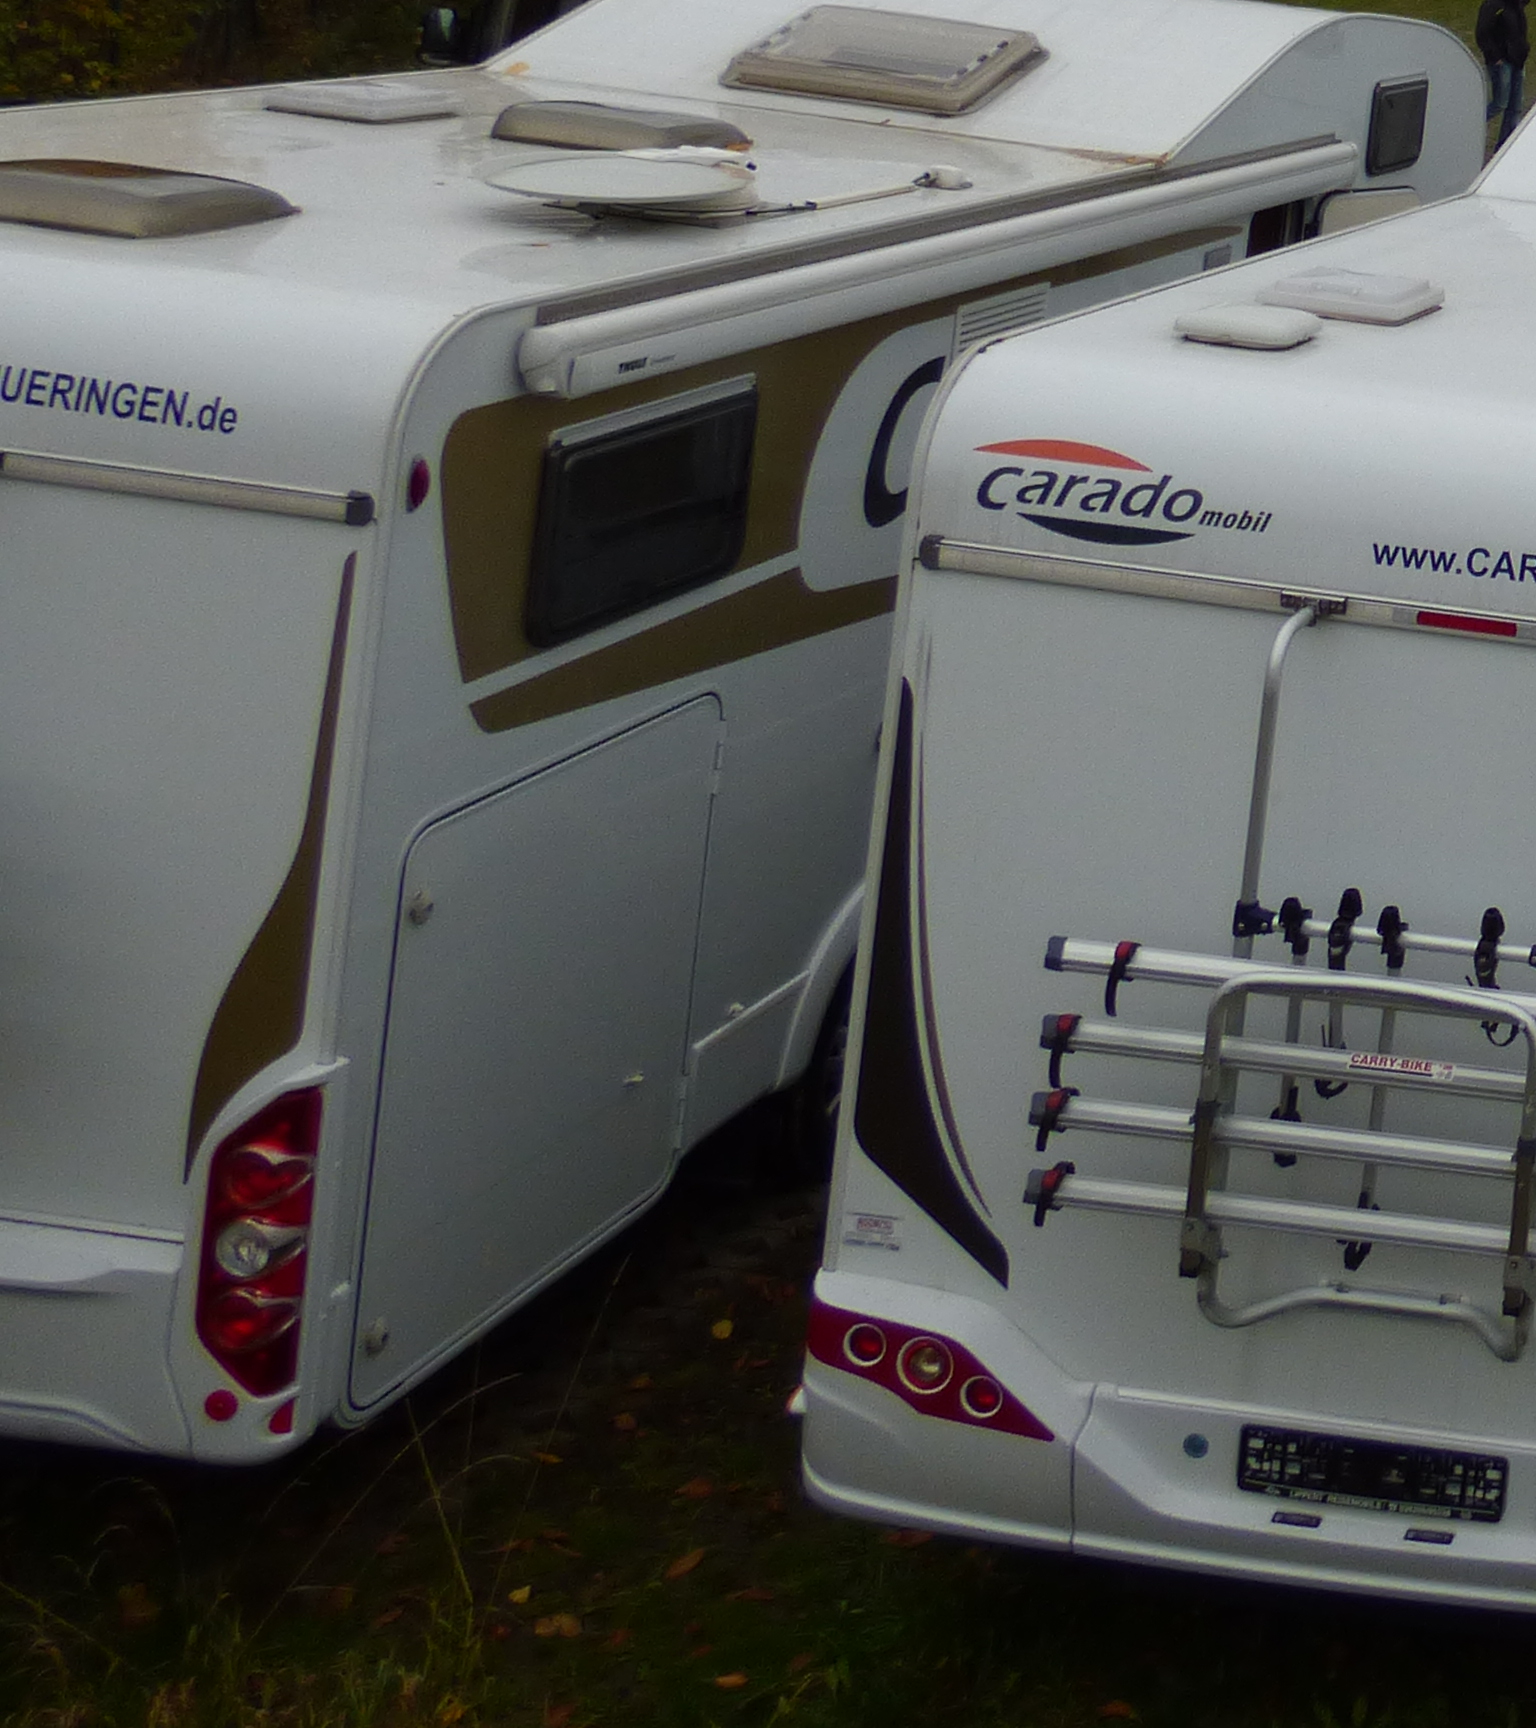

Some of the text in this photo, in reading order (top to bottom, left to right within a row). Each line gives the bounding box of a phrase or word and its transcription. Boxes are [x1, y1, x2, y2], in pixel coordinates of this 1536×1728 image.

[0, 365, 238, 434] UERINGEN.de
[976, 466, 1273, 533] carado mobil
[1351, 1053, 1434, 1072] CARRY-BIKE
